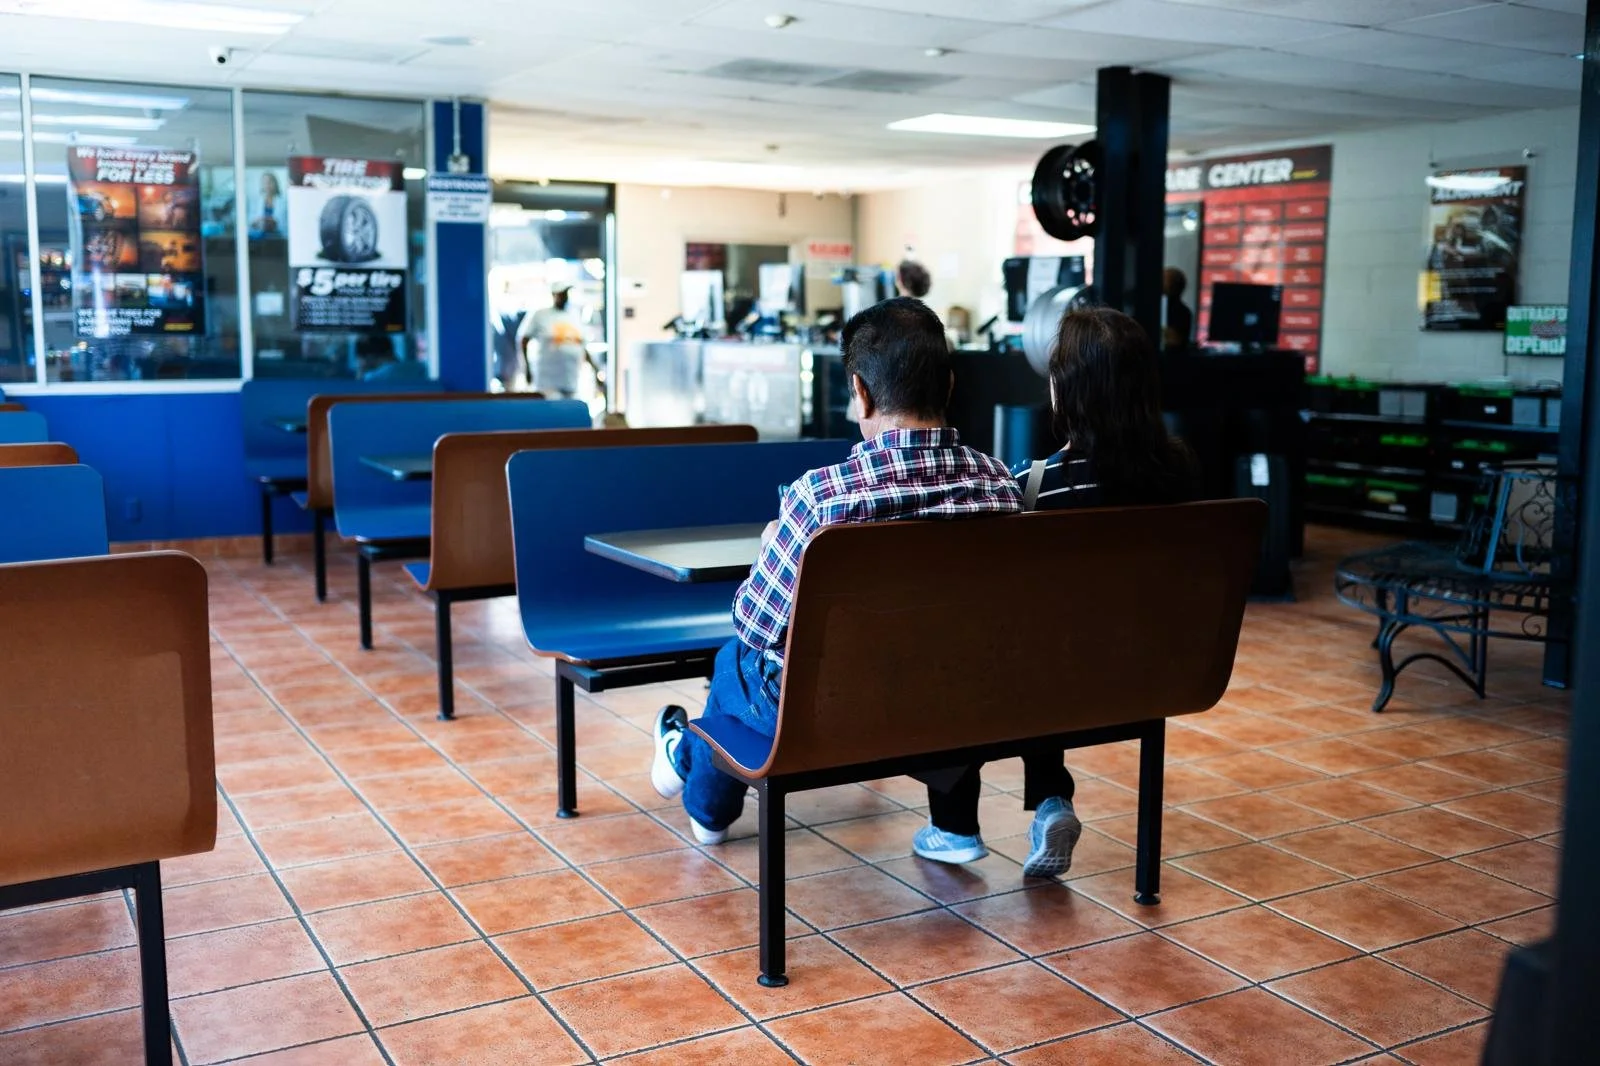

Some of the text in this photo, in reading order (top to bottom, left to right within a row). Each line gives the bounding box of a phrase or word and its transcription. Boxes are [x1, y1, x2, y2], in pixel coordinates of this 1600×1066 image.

[323, 158, 368, 176] TIRE
[1165, 157, 1294, 191] ARE CENTER
[97, 168, 175, 185] FOR LESS
[297, 268, 403, 297] $5 per tire
[1507, 308, 1568, 322] OUTRAGEO
[1507, 336, 1566, 354] DEPENDA
